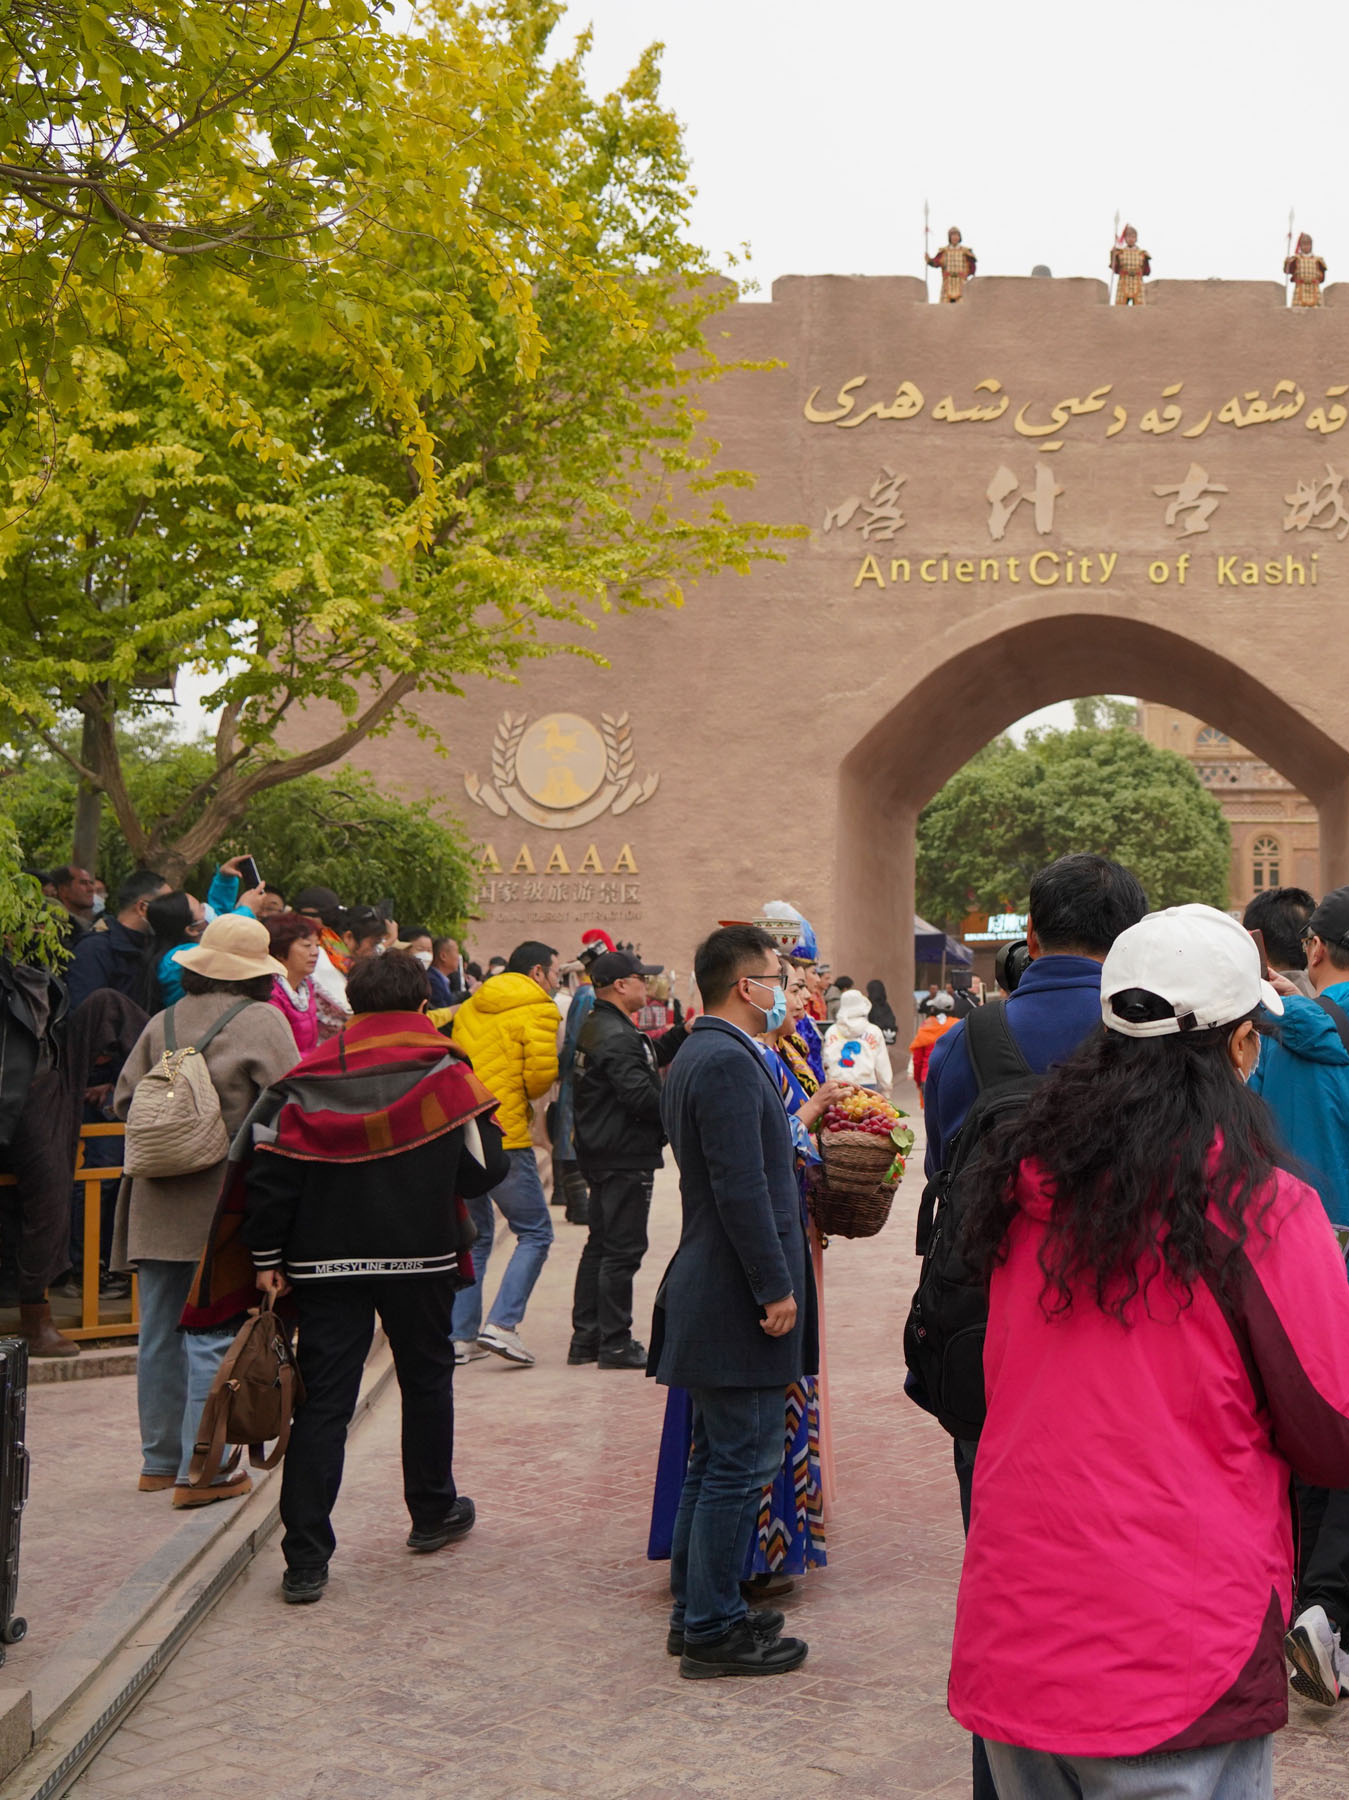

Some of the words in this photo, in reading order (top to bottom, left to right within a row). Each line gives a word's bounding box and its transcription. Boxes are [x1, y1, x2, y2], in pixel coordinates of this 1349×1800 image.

[1148, 553, 1192, 585] of
[1216, 552, 1320, 586] Kashi
[315, 1261, 386, 1274] MESSYLINE
[390, 1261, 424, 1270] PARIS
